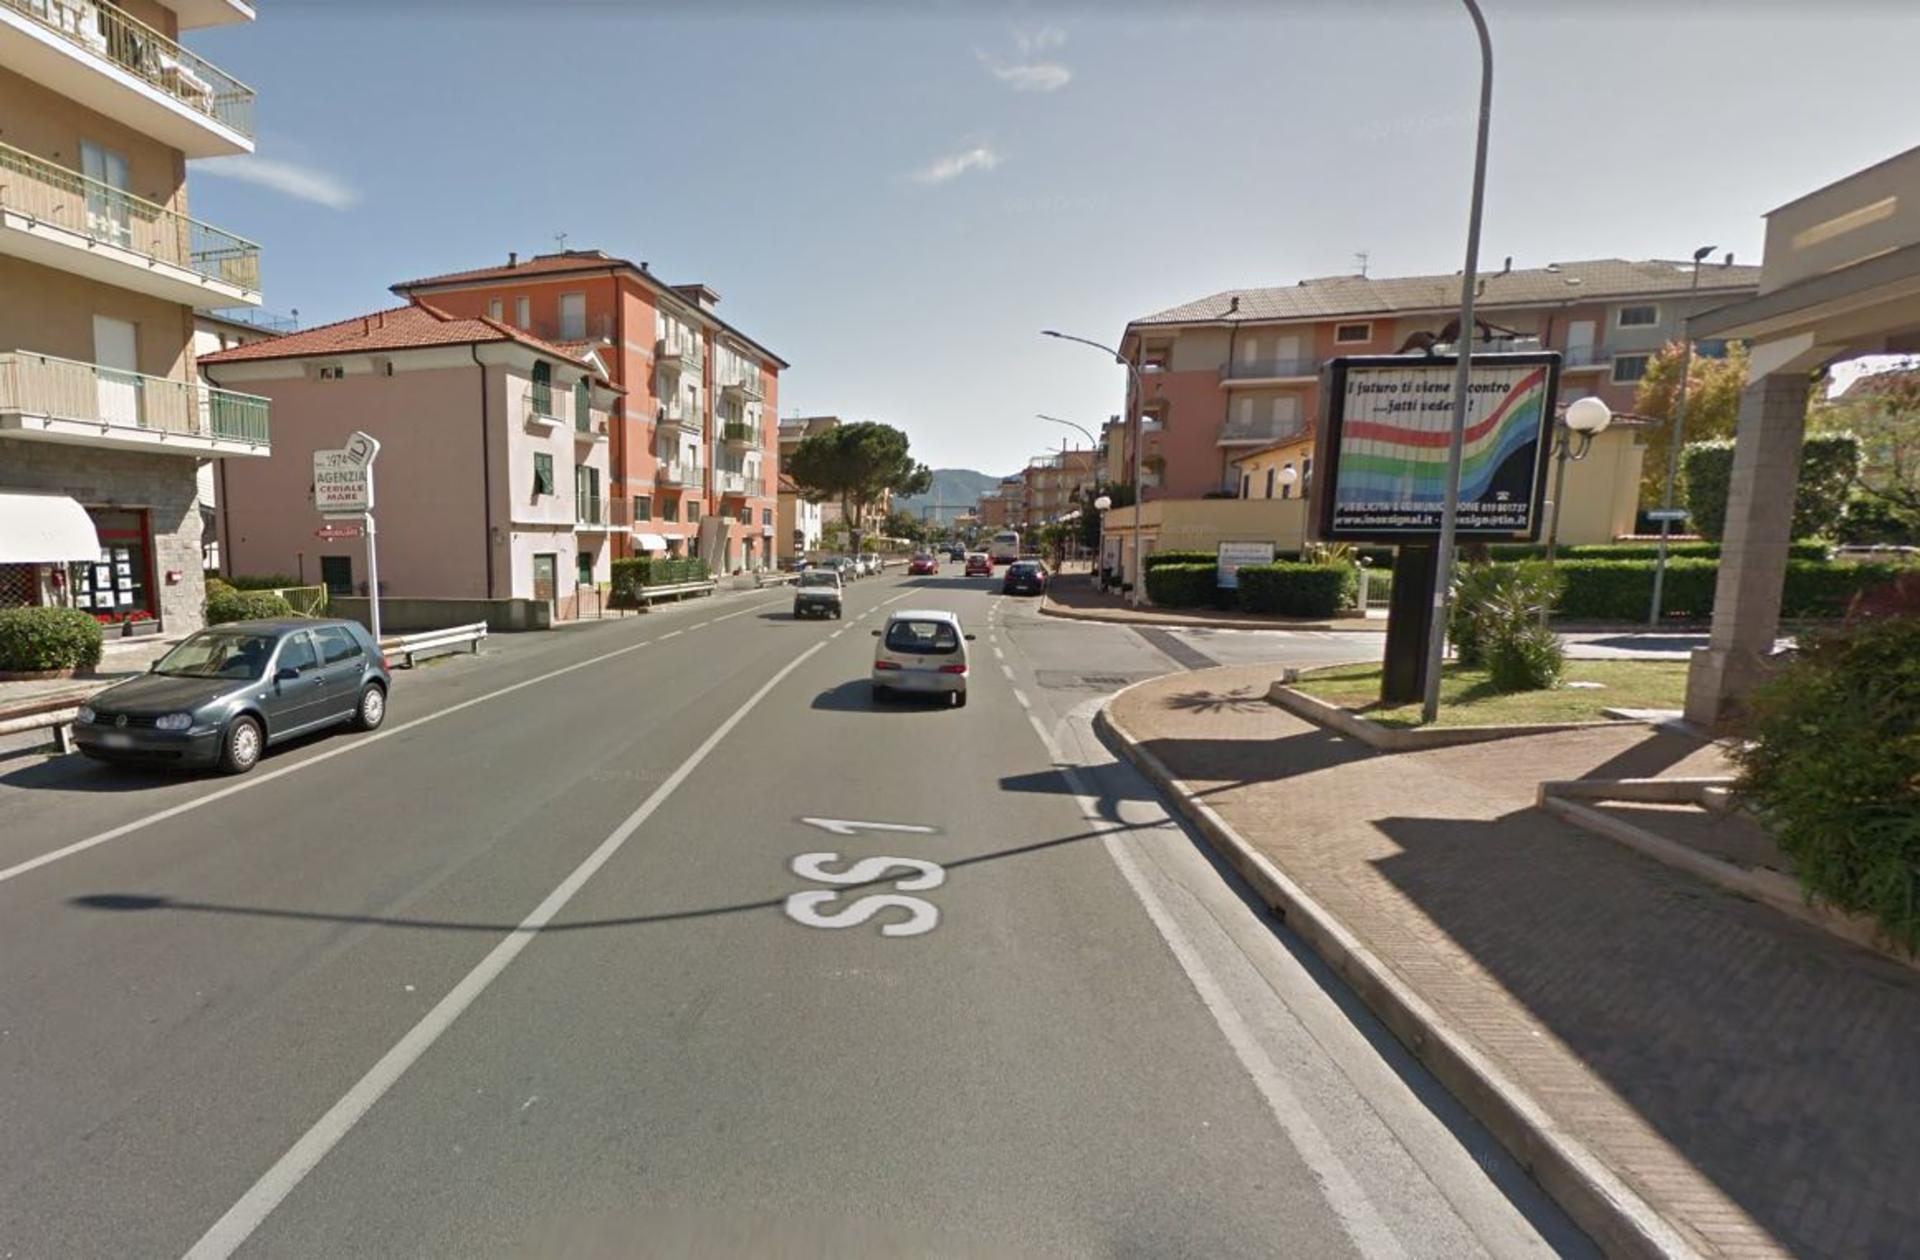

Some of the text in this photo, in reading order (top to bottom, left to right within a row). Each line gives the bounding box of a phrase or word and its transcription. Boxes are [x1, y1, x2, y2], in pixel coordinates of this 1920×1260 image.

[1401, 381, 1412, 394] ti
[317, 471, 367, 484] AGENZIA
[319, 485, 364, 493] CERIALE
[326, 493, 358, 501] MARE
